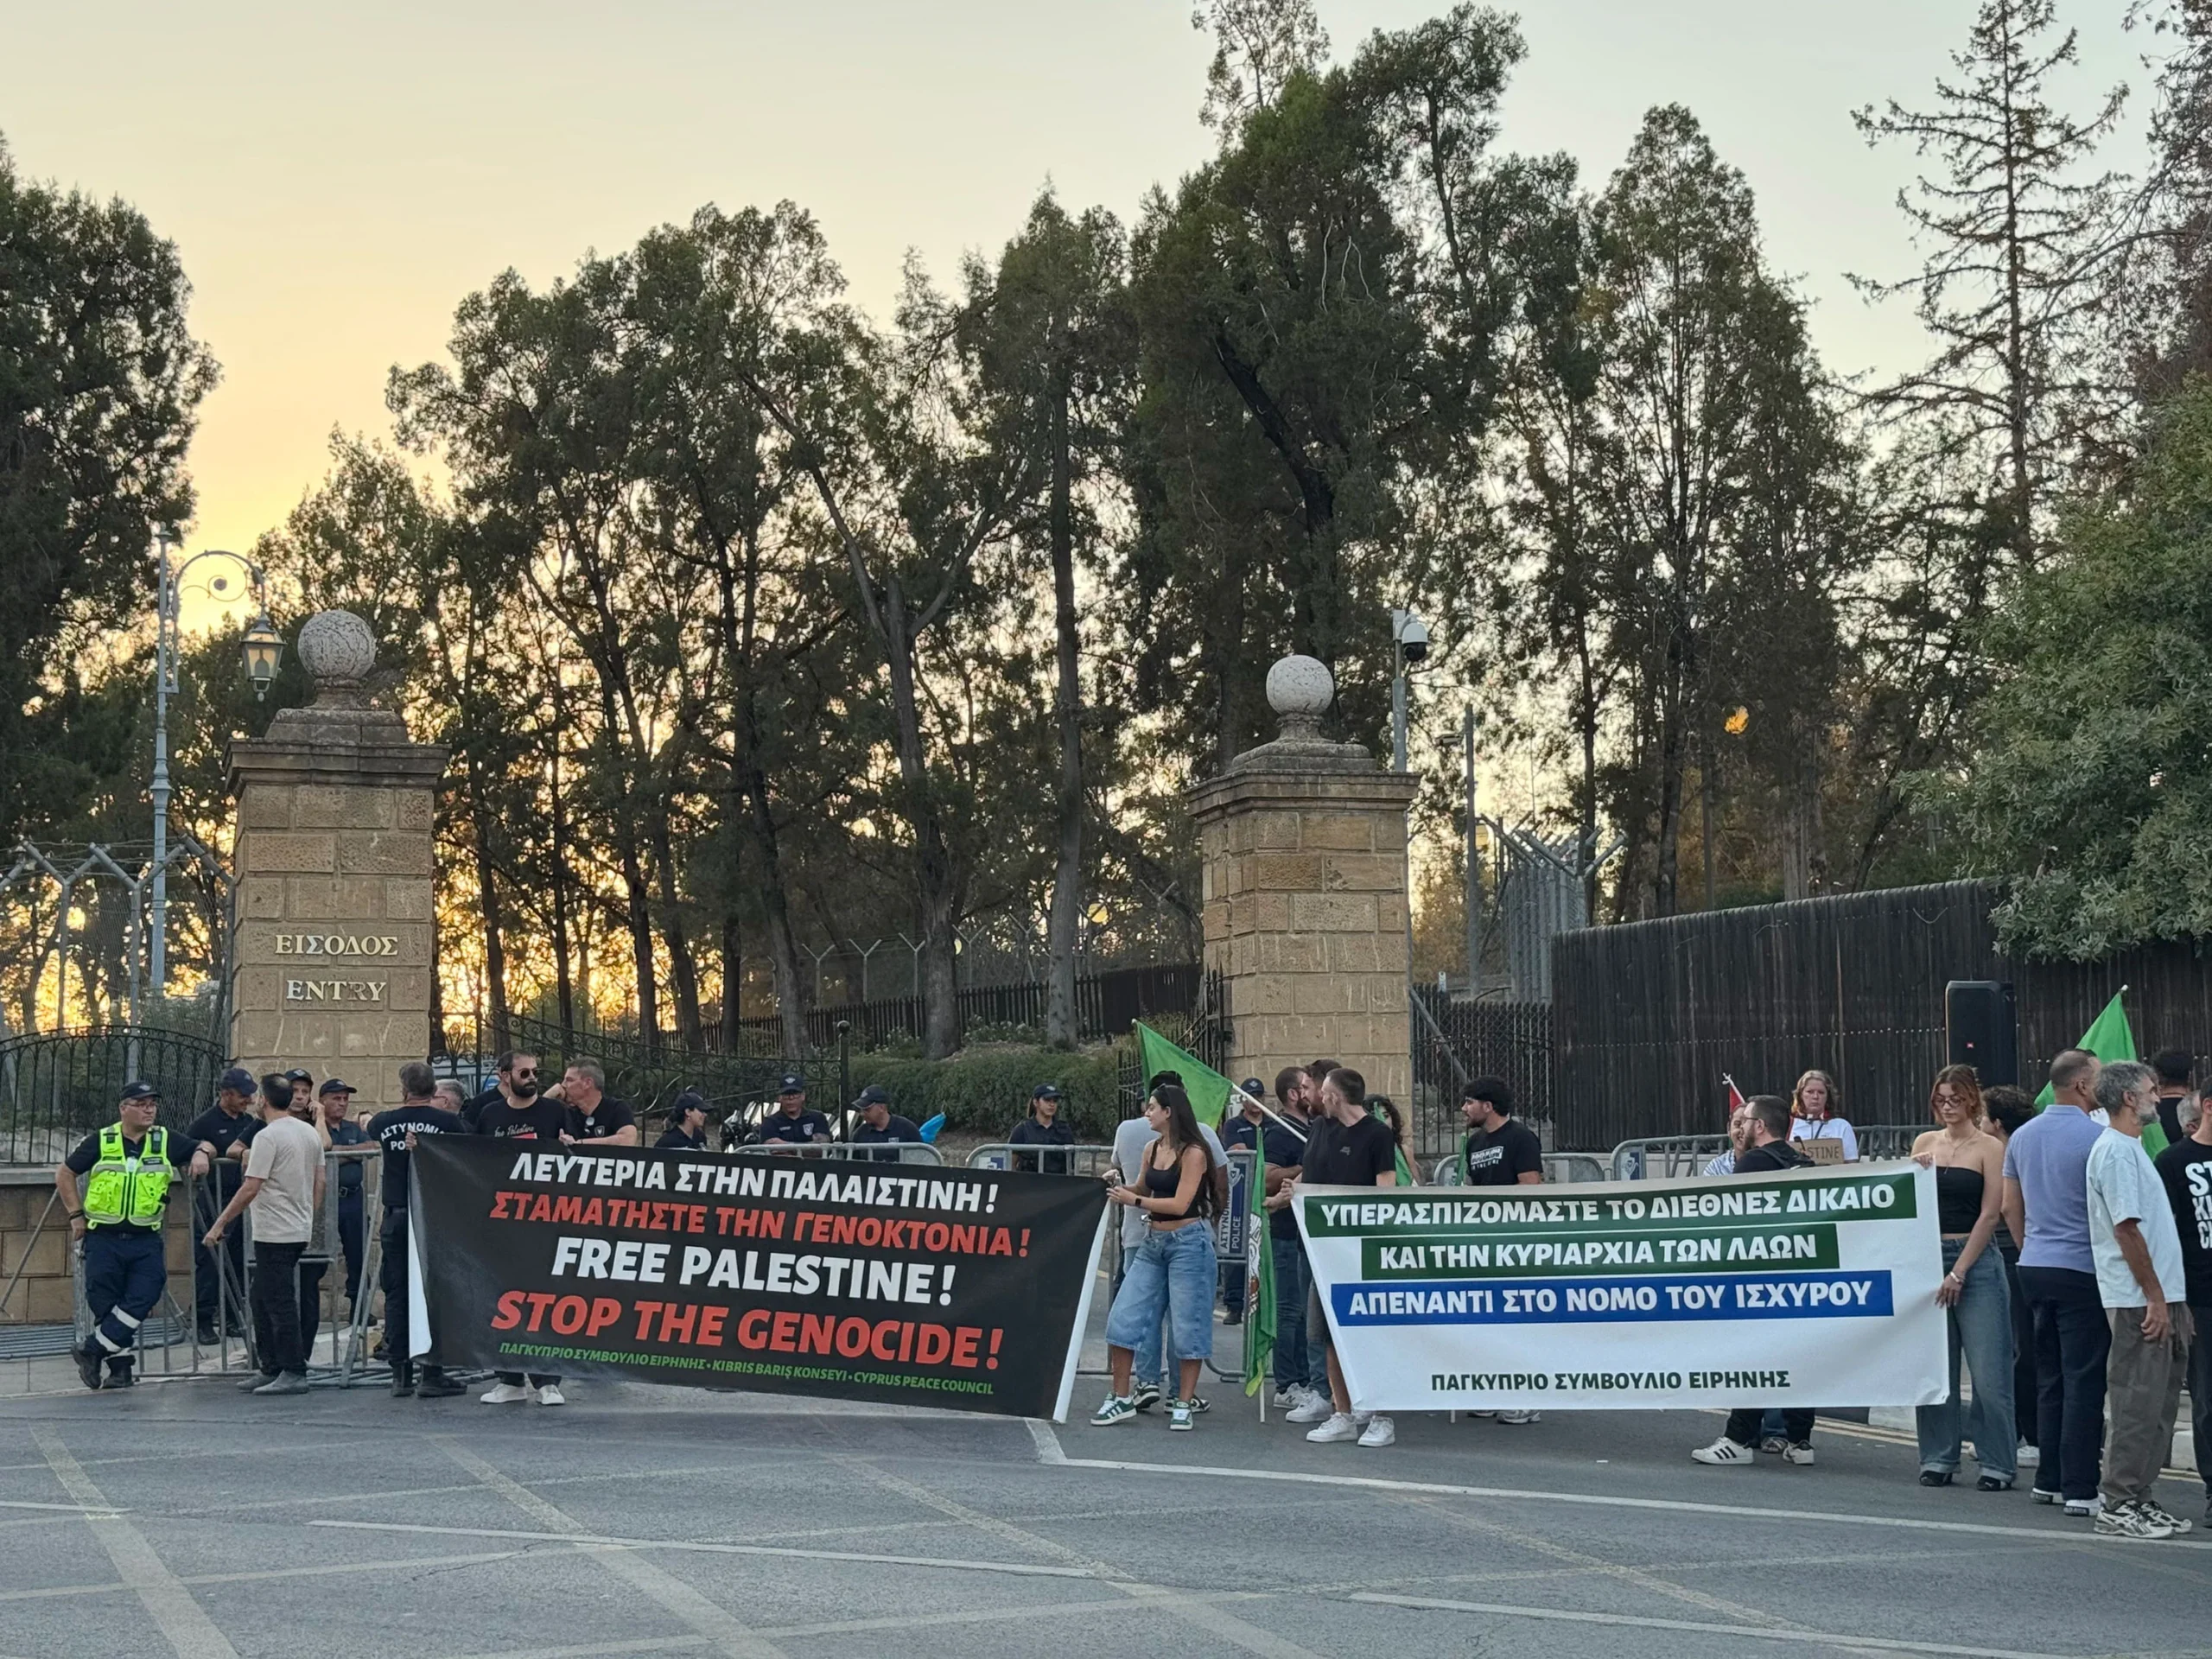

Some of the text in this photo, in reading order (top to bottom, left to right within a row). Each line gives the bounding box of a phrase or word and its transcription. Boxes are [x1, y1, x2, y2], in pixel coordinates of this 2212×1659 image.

[275, 934, 398, 956] ΕΙΣΟΔΟΣ
[286, 979, 387, 1001] ENTRY
[380, 1122, 445, 1141] ΑΣΤΥΝΟΜΙ
[1807, 1146, 1840, 1159] STINE
[510, 1153, 999, 1214] ΛΕΥΤΕΡΙΑ ΣΤΗΝ ΠΑΛΑΙΣΤΙΝΗ!
[1220, 1193, 1230, 1249] ΑΣΤΥΝΟ
[1321, 1184, 1895, 1227] ΥΠΕΡΑΣΠΙΖΟΜΑΣΤΕ ΤΟ ΔΙΕΘΝΕΣ ΔΙΚΑΙΟ
[489, 1191, 1031, 1257] ΣΤΑΜΑΤΗΣΤΕ ΤΗΝ ΓΕΝΟΚΤΟΝΙΑ!
[1231, 1216, 1242, 1249] POLICE
[1381, 1234, 1816, 1269] ΚΑΙ ΤΗΝ ΚΥΡΙΑΡΧΙΑ ΤΩΝ ΛΑΩΝ
[551, 1236, 957, 1306] FREE PALESTINE!
[1349, 1281, 1872, 1315] ΑΠΕΝΑΝΤΙ ΣΤΟ ΝΟΜΟ ΤΟΥ ΙΣΧΥΡΟΥ
[490, 1290, 1004, 1370] STOP THE GENOCIDE!
[499, 1342, 707, 1369] ΠΑΓΚΥΠΡΙΟ ΣΥΜΒΟΥΛΙΟ ΕΙΡΗΝΗΣ
[712, 1358, 847, 1382] KIBRIS BARIŞ KONSEYI
[854, 1371, 994, 1395] CYPRUS PEACE COUNCIL
[1432, 1370, 1790, 1391] ΠΑΓΚΥΠΡΙΟ ΣΥΜΒΟΥΛΙΟ ΕΙΡΗΝΗΣ
